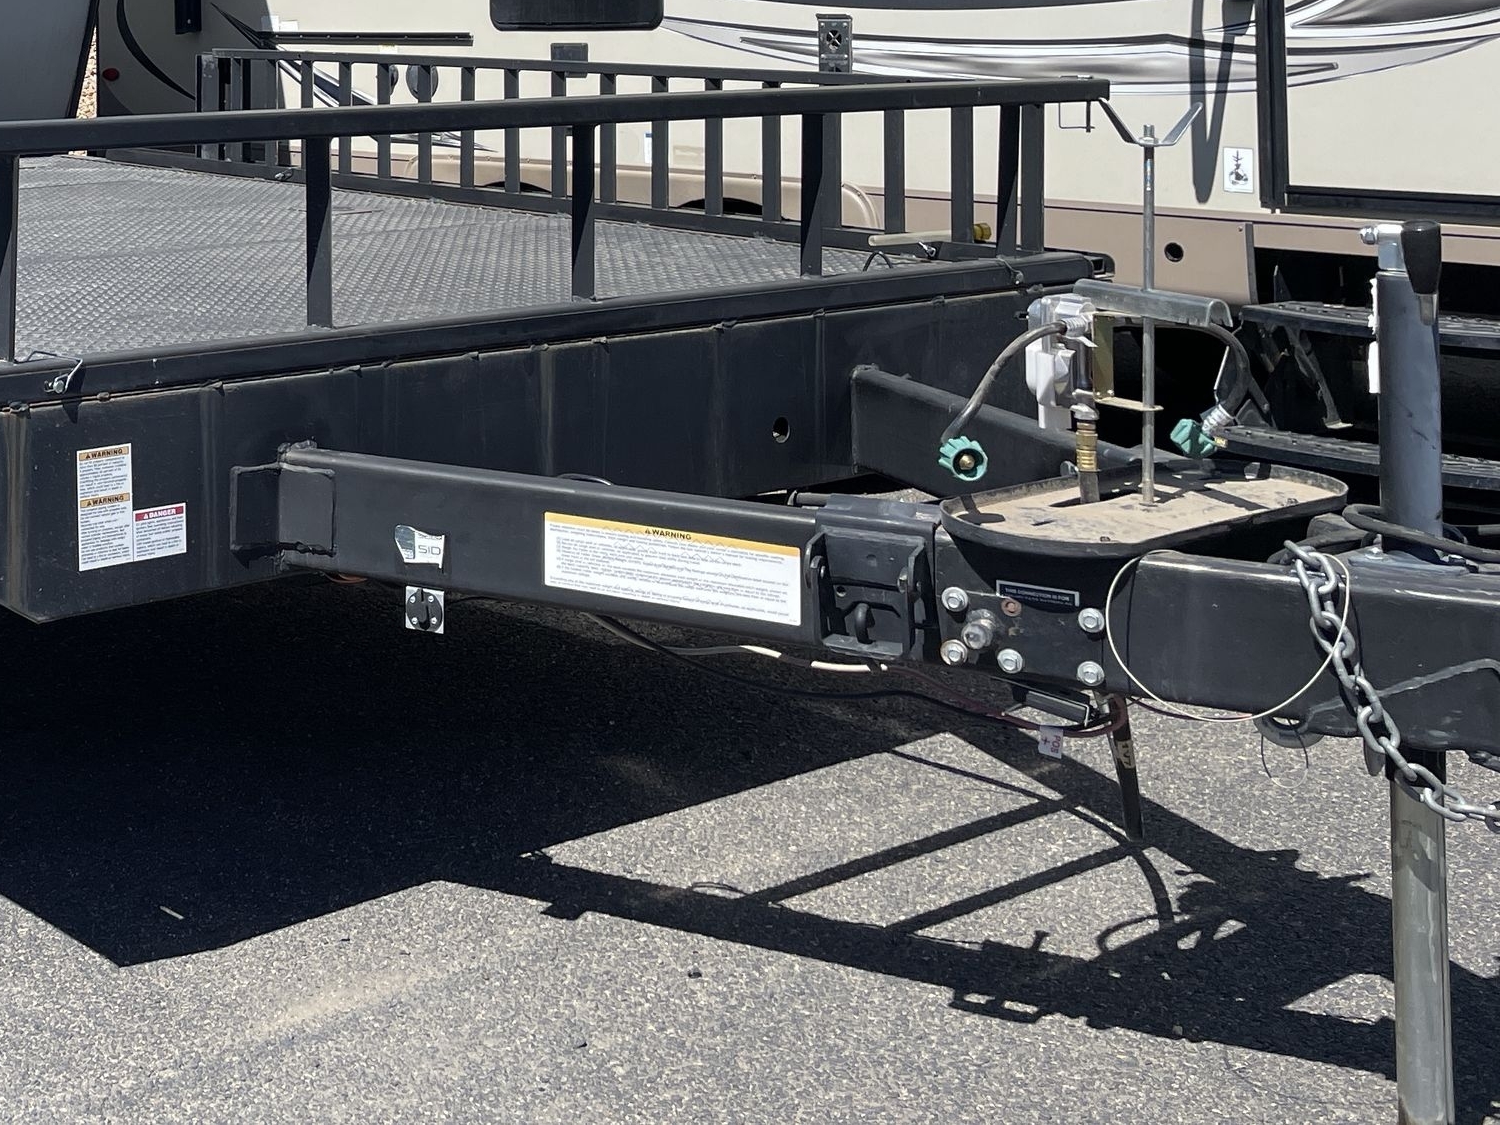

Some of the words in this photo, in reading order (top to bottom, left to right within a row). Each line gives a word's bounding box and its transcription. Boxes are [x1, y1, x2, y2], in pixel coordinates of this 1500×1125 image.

[91, 448, 123, 458] WARNING
[92, 495, 124, 506] WARNING
[149, 508, 177, 519] DANGER
[652, 529, 692, 540] WARNING
